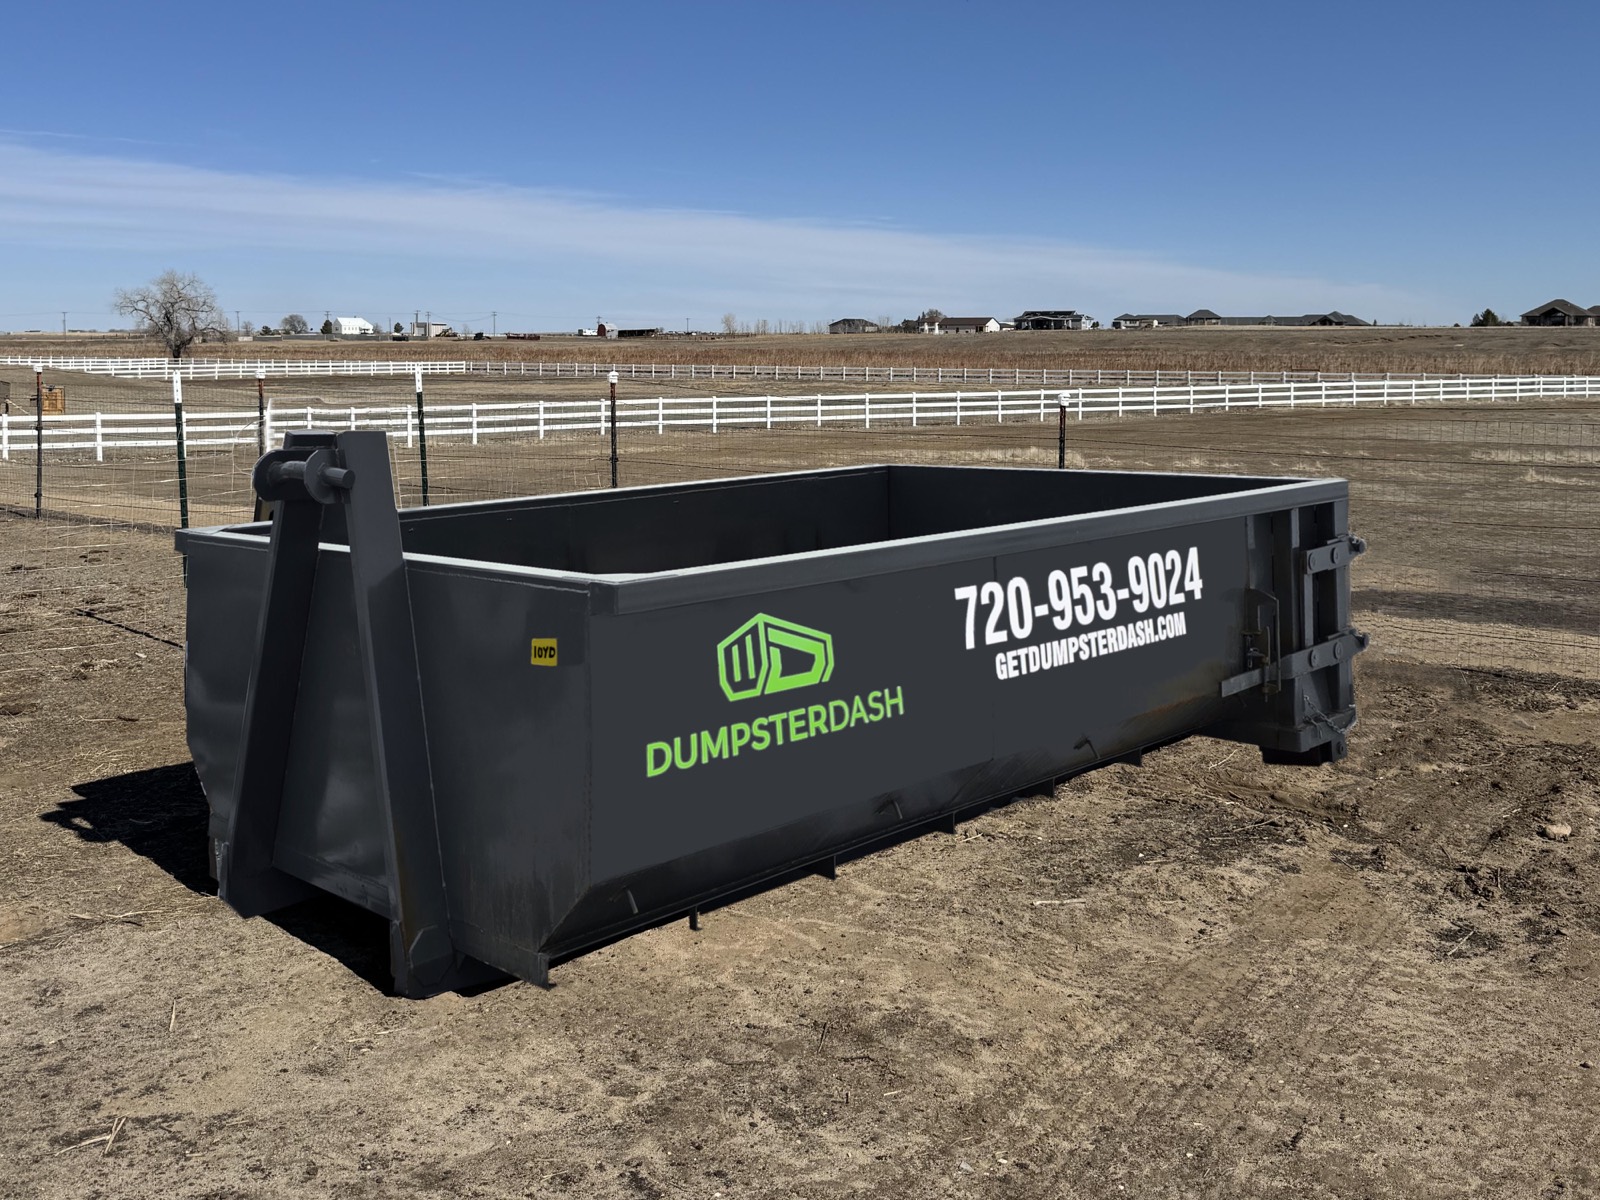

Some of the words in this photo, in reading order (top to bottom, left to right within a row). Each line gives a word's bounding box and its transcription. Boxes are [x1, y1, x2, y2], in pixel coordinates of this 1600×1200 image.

[954, 546, 1204, 650] 720-953-9024
[533, 645, 556, 659] 10YD
[995, 611, 1187, 681] GETDUMPSTERDASH.COM
[646, 686, 904, 778] DUMPSTERDASH
